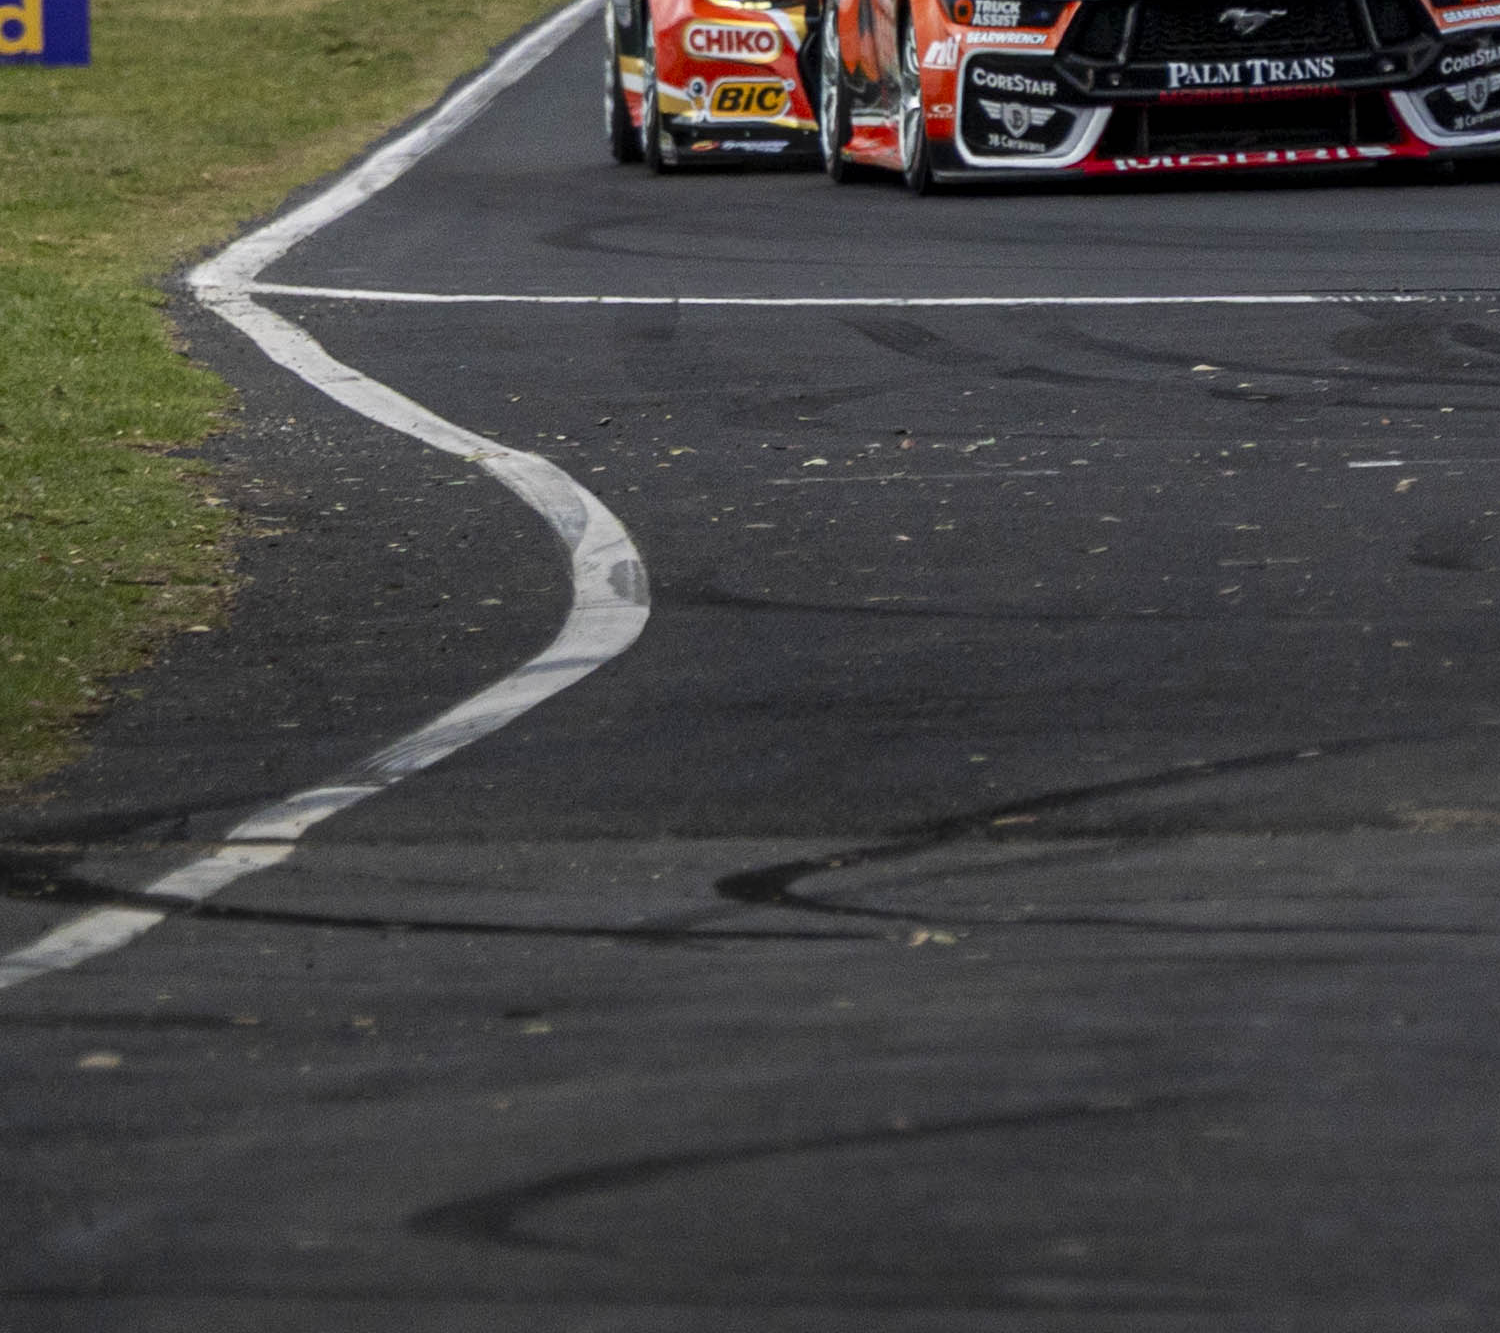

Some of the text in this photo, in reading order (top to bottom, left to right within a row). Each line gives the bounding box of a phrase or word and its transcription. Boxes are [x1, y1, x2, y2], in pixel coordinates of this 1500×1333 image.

[974, 0, 1021, 14] TRUCK
[972, 14, 1020, 27] ASSIST
[689, 28, 776, 54] CHIKO
[966, 31, 1048, 46] GEARWRENCH
[1168, 56, 1335, 89] PALM TRANS
